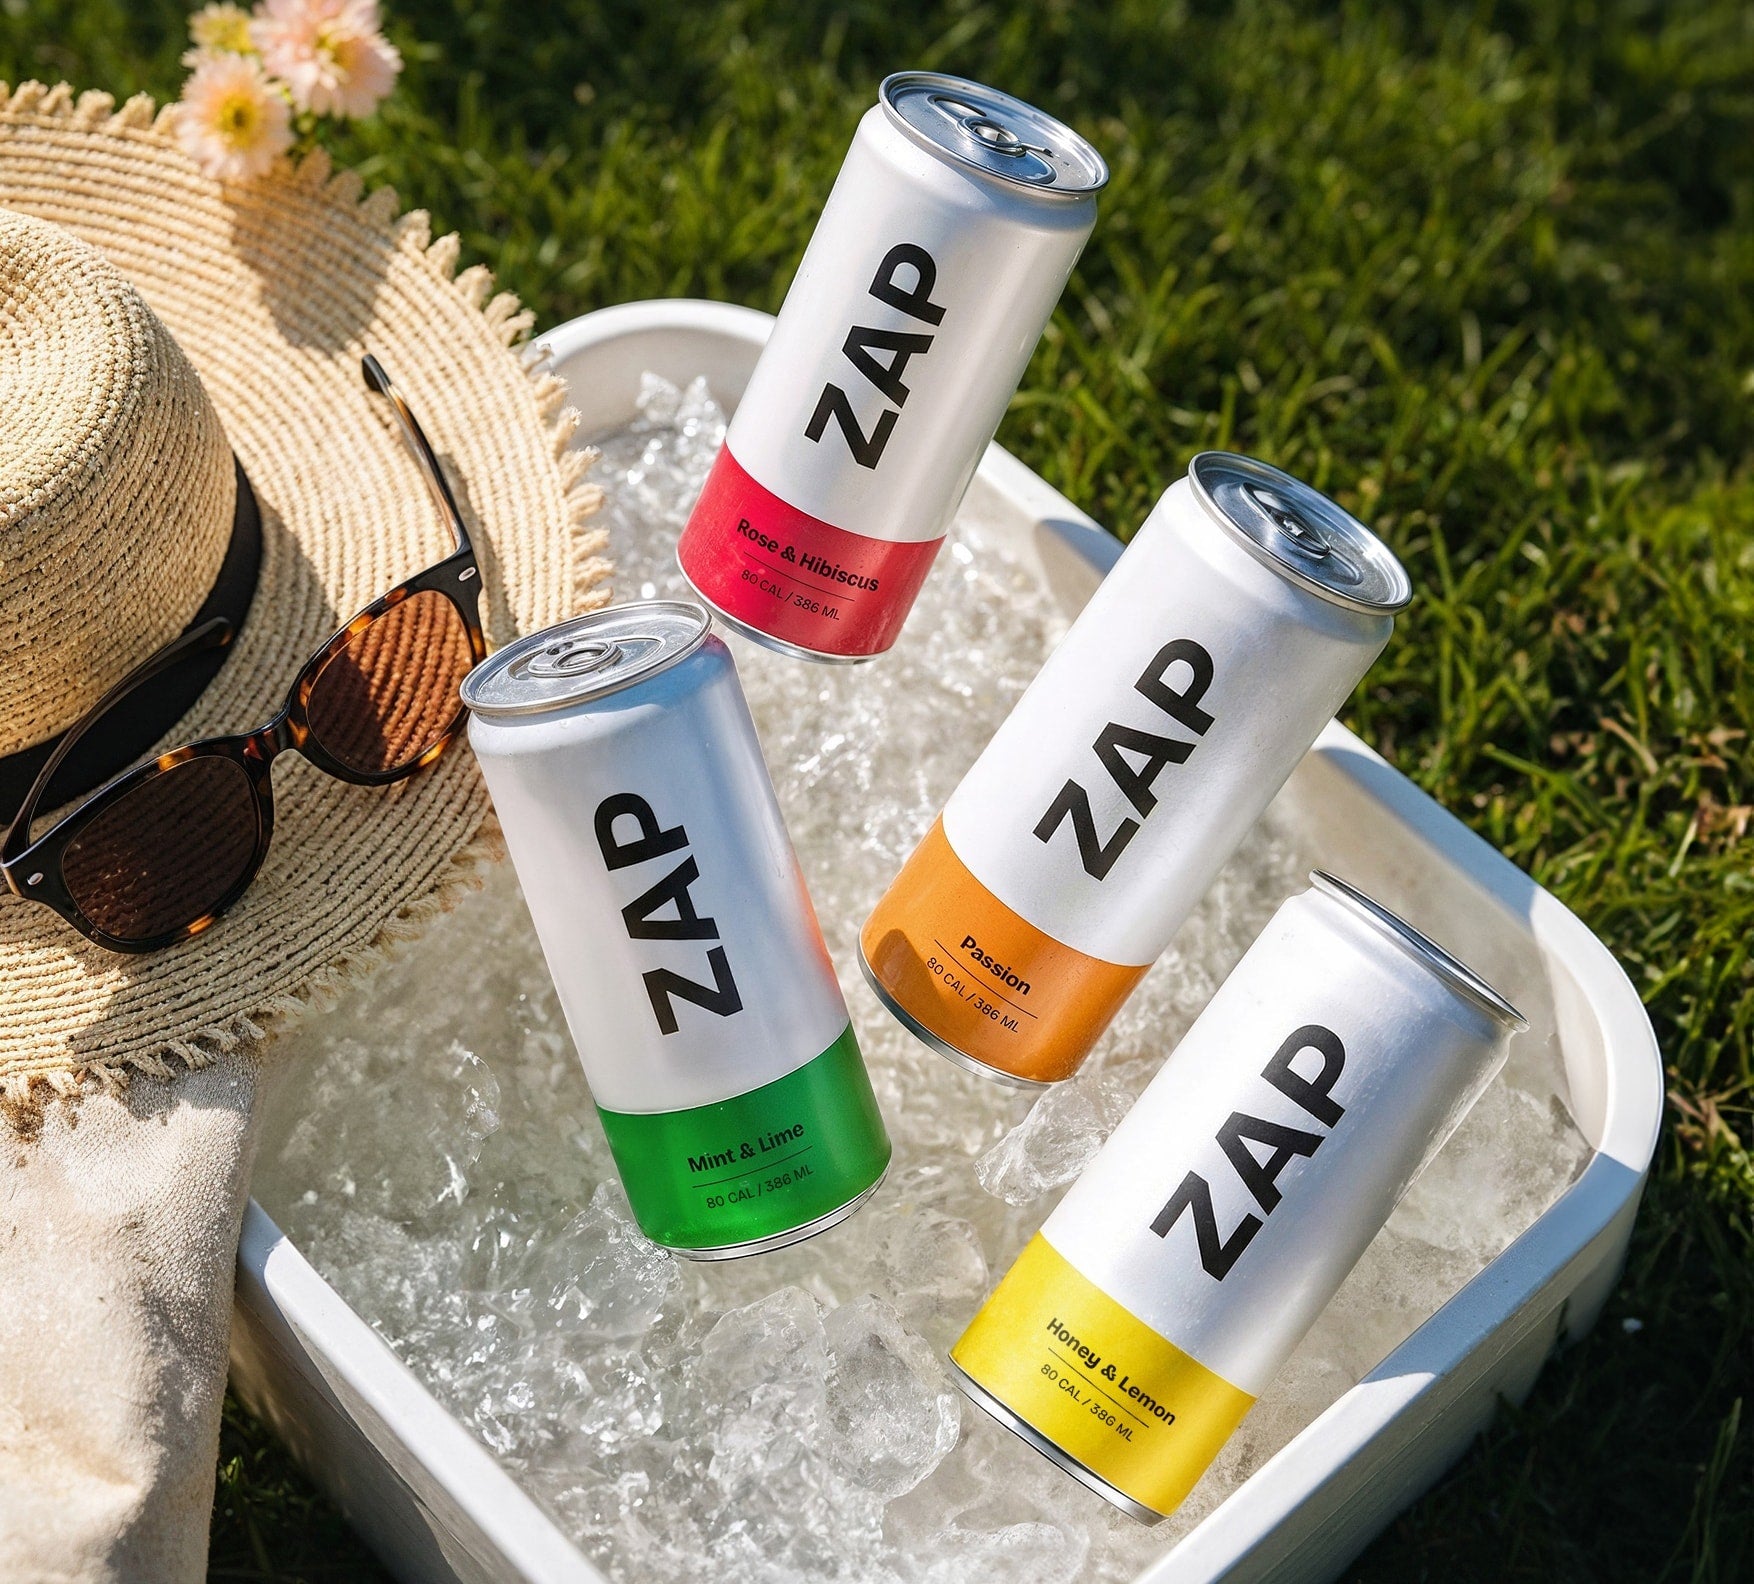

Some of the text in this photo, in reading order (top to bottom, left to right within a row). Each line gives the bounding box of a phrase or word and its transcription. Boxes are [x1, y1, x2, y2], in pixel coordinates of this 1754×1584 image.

[803, 242, 947, 470] ZAP
[737, 518, 880, 592] Rose & Hibiscus
[741, 569, 840, 621] 80 CAL / 386 ML
[1032, 638, 1216, 882] ZAP
[594, 792, 744, 1036] ZAP
[926, 957, 1019, 1033] 80 CAL / 386 ML
[960, 935, 1031, 996] Passion
[687, 1123, 805, 1173] Mint & Lime
[706, 1164, 814, 1209] 80 CAL / 386 ML
[1149, 1024, 1346, 1282] ZAP
[1040, 1363, 1059, 1381] 80
[1058, 1378, 1080, 1402] CAL
[1081, 1398, 1091, 1406] /
[1116, 1423, 1133, 1442] ML
[1046, 1317, 1176, 1426] Honey & Lemon
